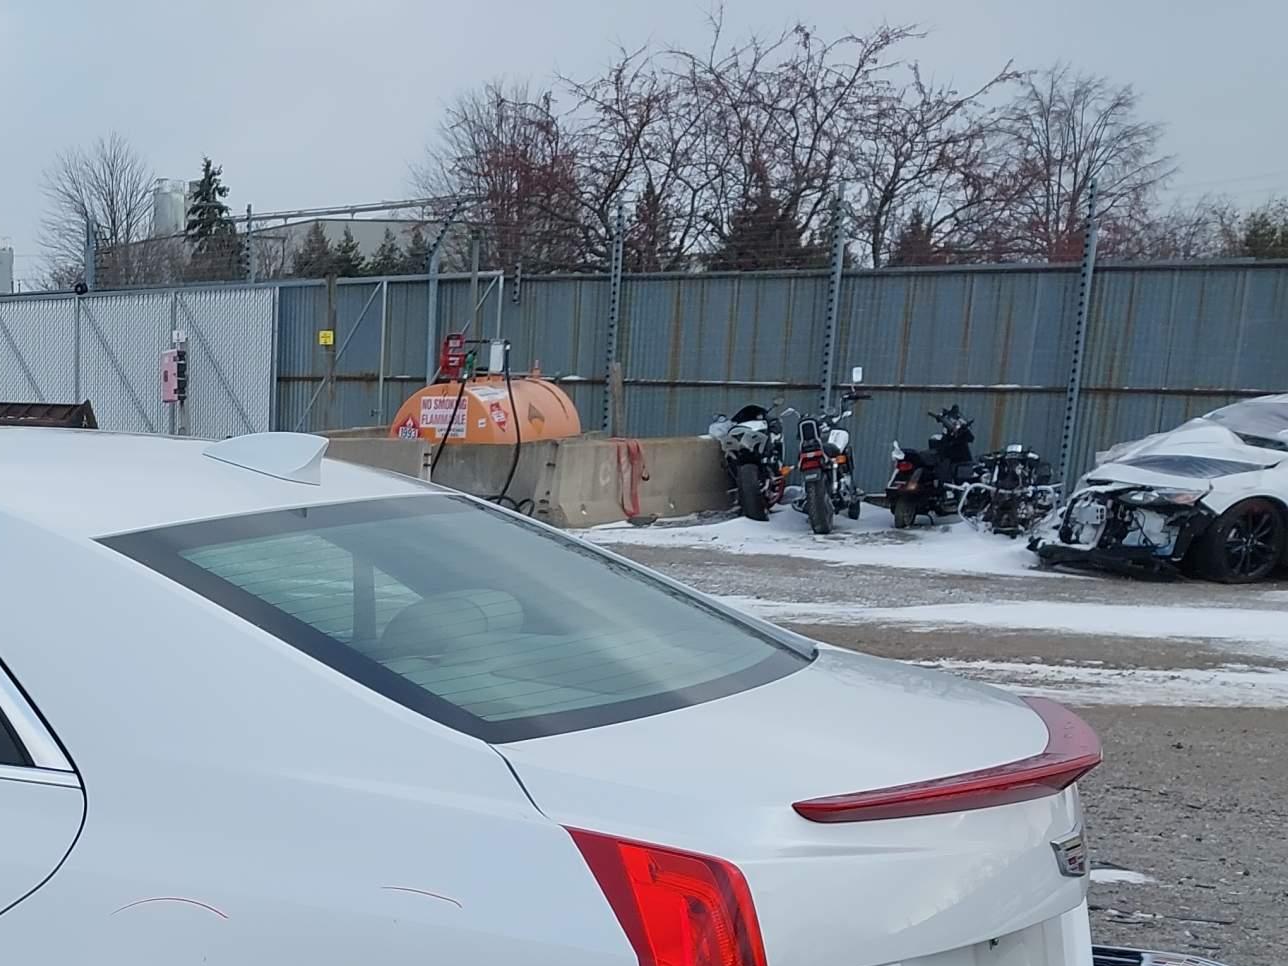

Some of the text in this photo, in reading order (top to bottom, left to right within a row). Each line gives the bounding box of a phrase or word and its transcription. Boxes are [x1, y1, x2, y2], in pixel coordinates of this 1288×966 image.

[422, 398, 467, 410] NO SMOKNG
[400, 427, 417, 438] 1993
